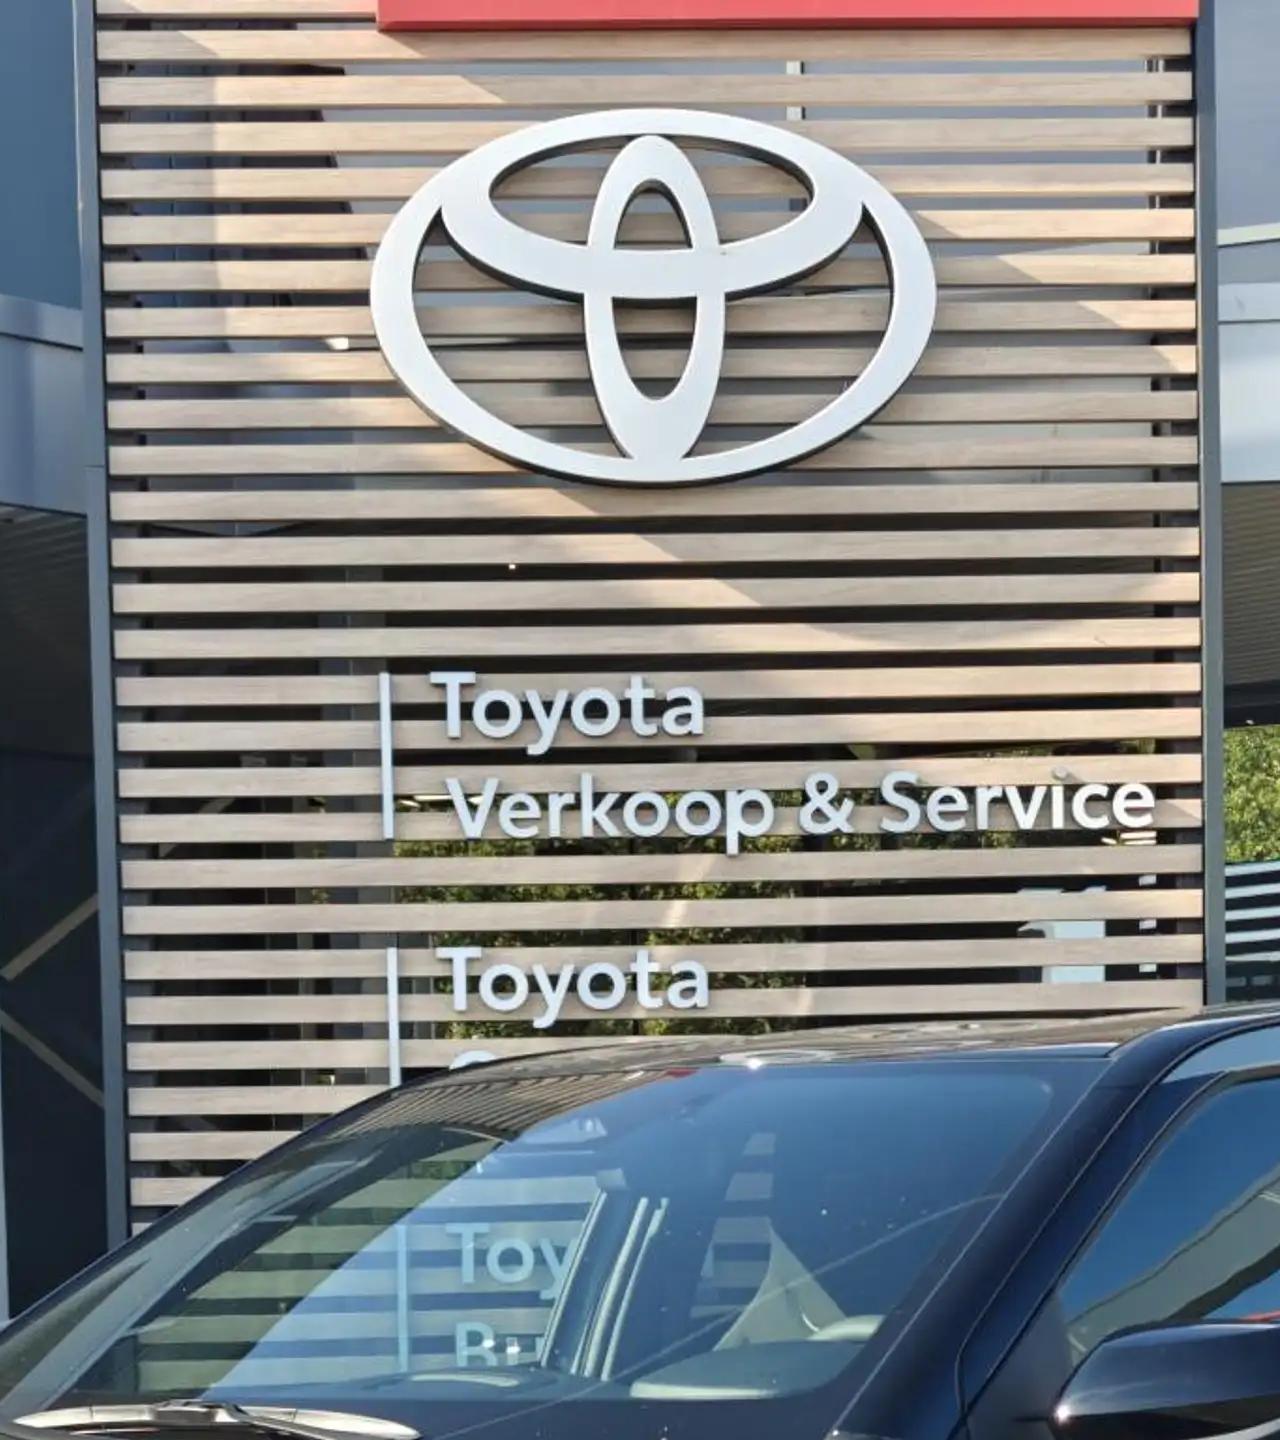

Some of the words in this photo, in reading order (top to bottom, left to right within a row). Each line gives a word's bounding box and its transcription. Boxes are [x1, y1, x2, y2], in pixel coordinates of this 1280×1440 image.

[429, 670, 706, 756] Toyota
[444, 772, 775, 856] Verkoop
[799, 771, 854, 836] &
[879, 766, 1156, 834] Service
[435, 946, 711, 1029] Toyota
[445, 1222, 580, 1300] Toy
